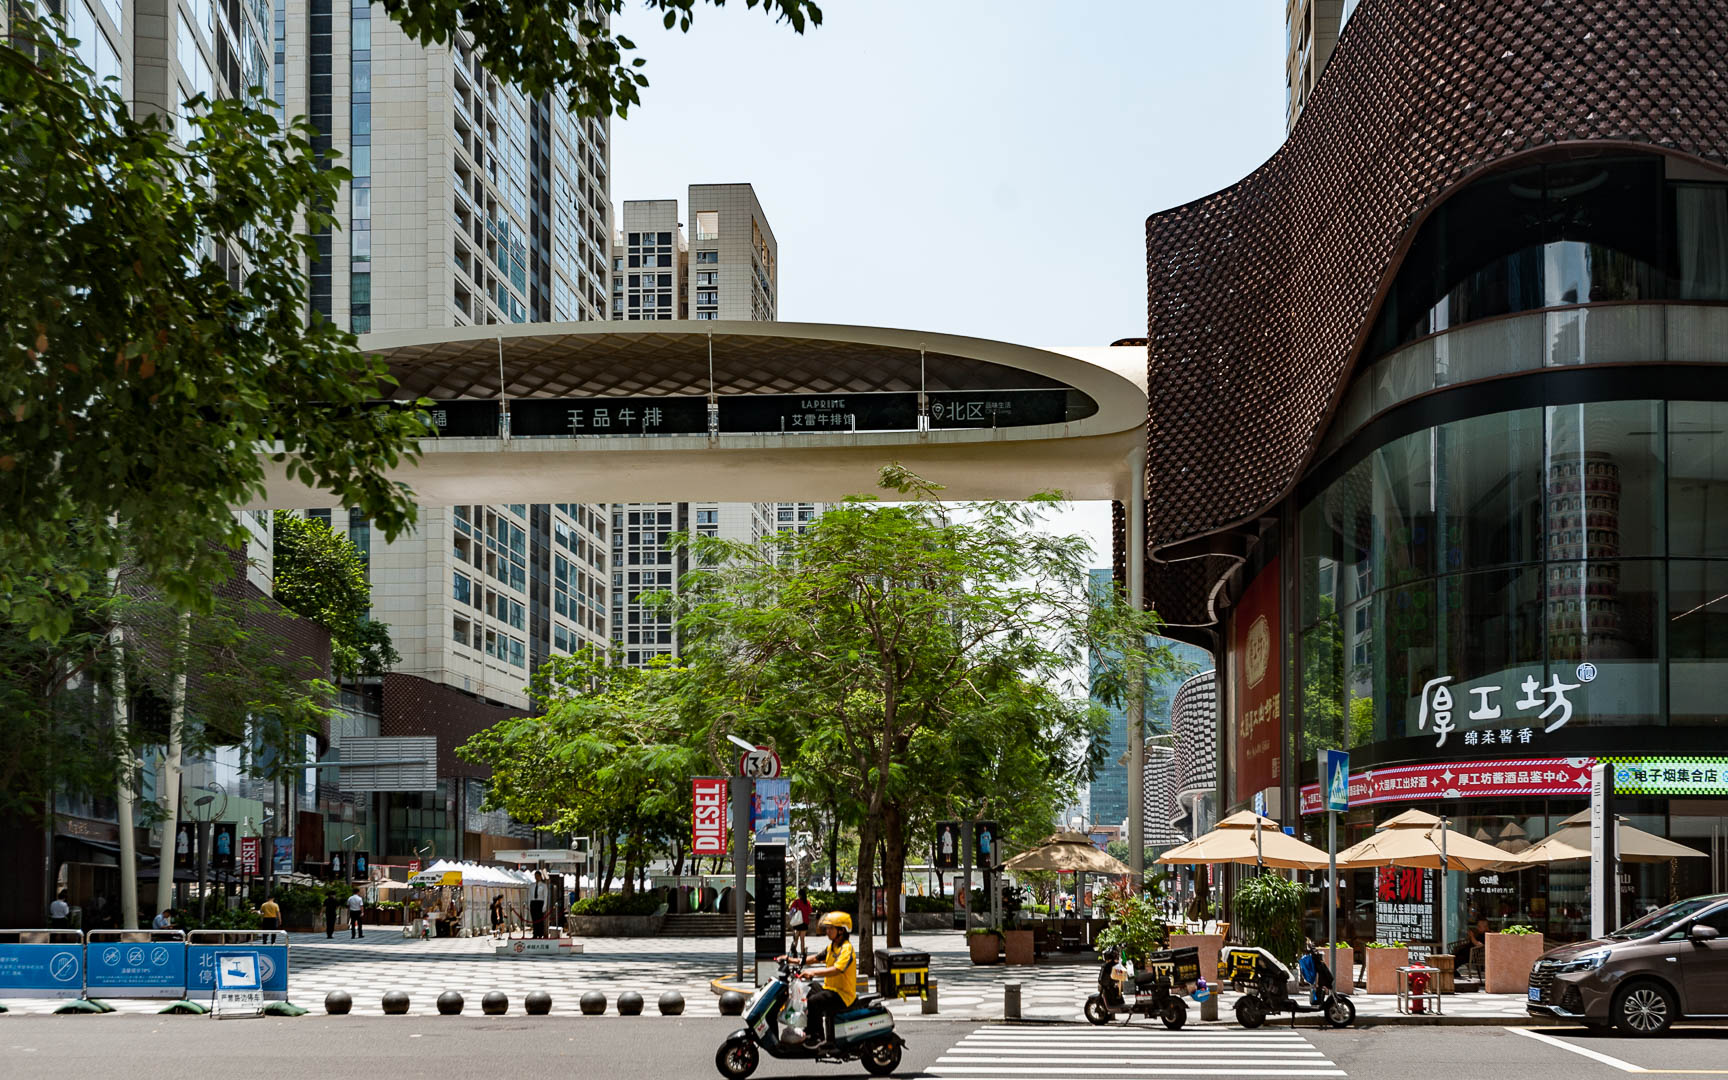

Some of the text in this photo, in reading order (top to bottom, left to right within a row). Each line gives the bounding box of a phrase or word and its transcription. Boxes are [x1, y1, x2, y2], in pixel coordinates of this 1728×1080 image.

[567, 407, 663, 428] 王品牛排
[791, 413, 853, 426] 艾雷牛排馆
[946, 401, 985, 421] 北区
[1418, 674, 1582, 748] 厚工坊
[1464, 728, 1533, 747] 绵柔酱香
[749, 757, 772, 775] 30
[1378, 776, 1428, 791] 大国厚工出好酒
[1457, 771, 1570, 786] 厚工坊酱酒品鉴中心
[1634, 768, 1717, 783] 电子烟集合店
[695, 784, 720, 850] DIESEL
